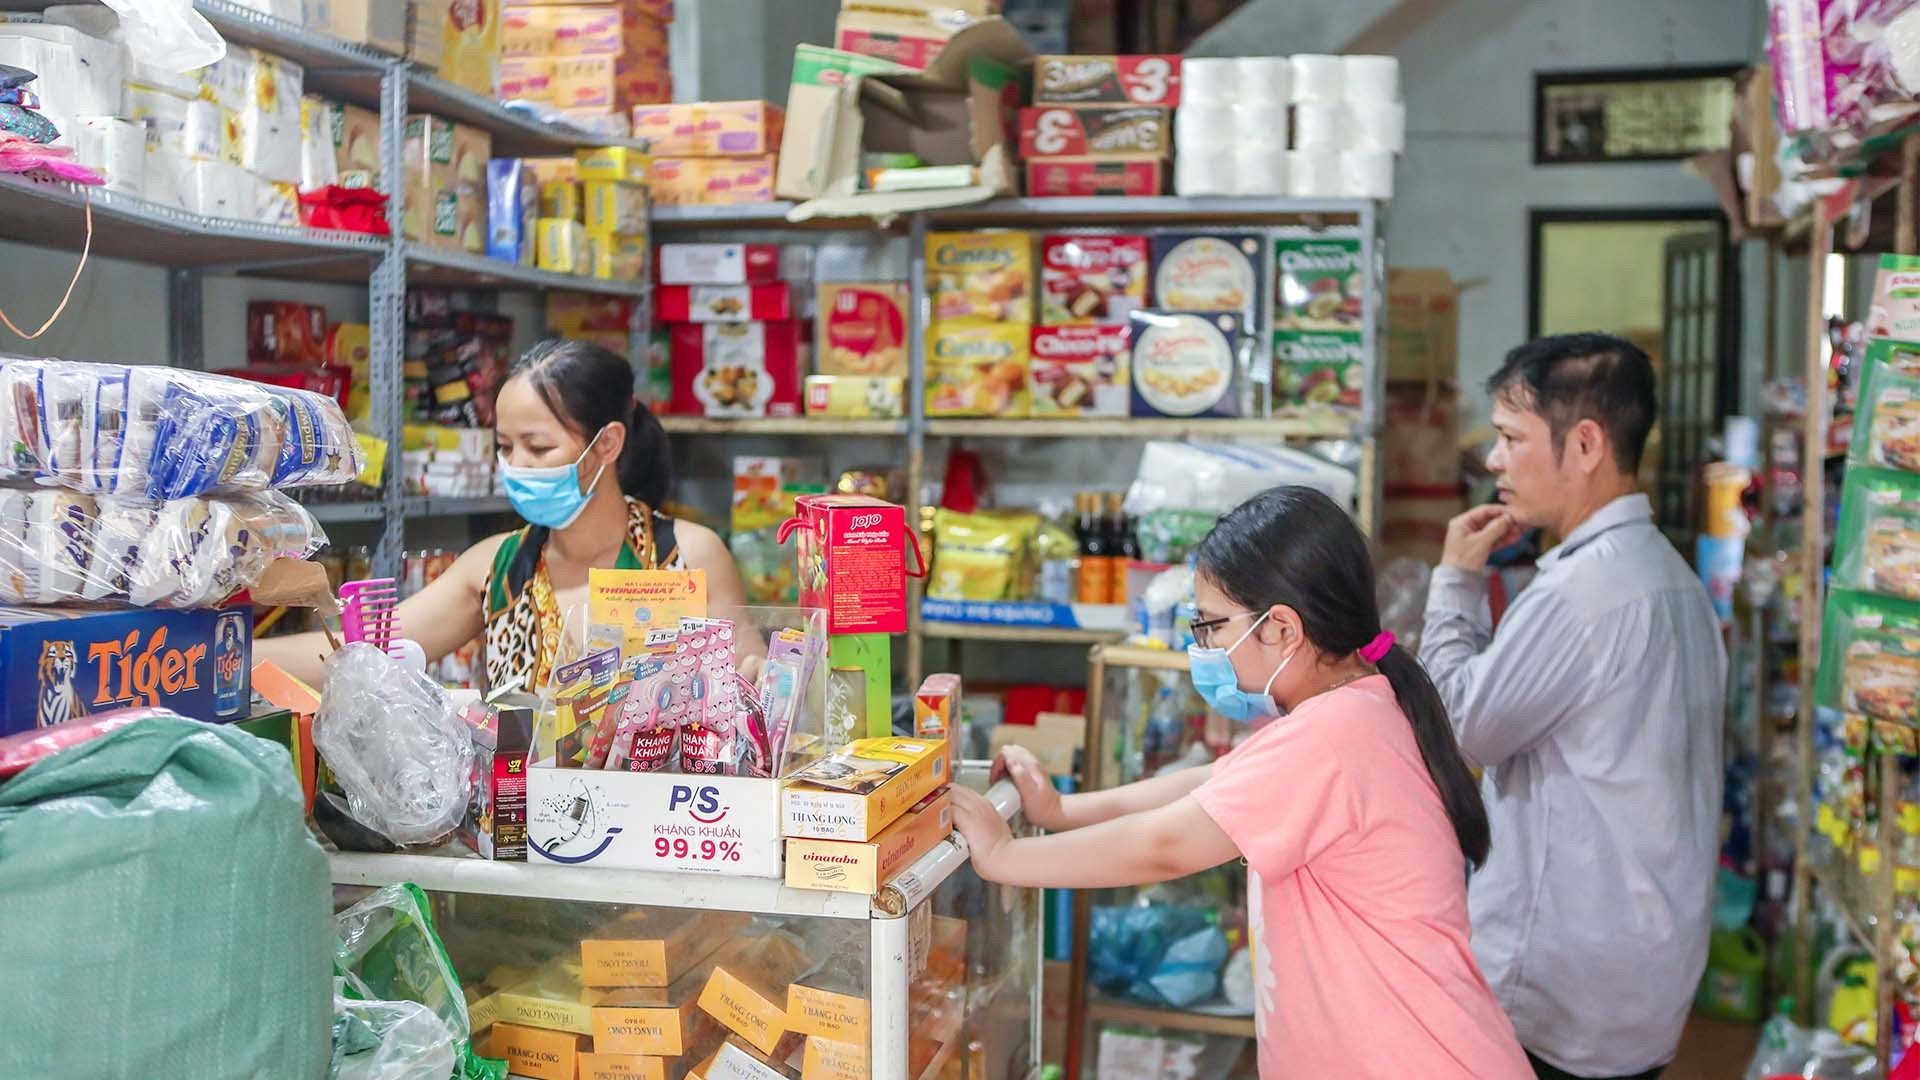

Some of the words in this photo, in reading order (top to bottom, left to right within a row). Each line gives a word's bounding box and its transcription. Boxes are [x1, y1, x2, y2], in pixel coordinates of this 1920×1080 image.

[850, 514, 882, 530] JOJO
[88, 625, 207, 708] Tiger
[216, 652, 241, 681] Tiger
[669, 785, 719, 814] P/S
[828, 814, 856, 825] LONG
[654, 824, 696, 836] KHÁNG
[803, 852, 858, 865] vinataba
